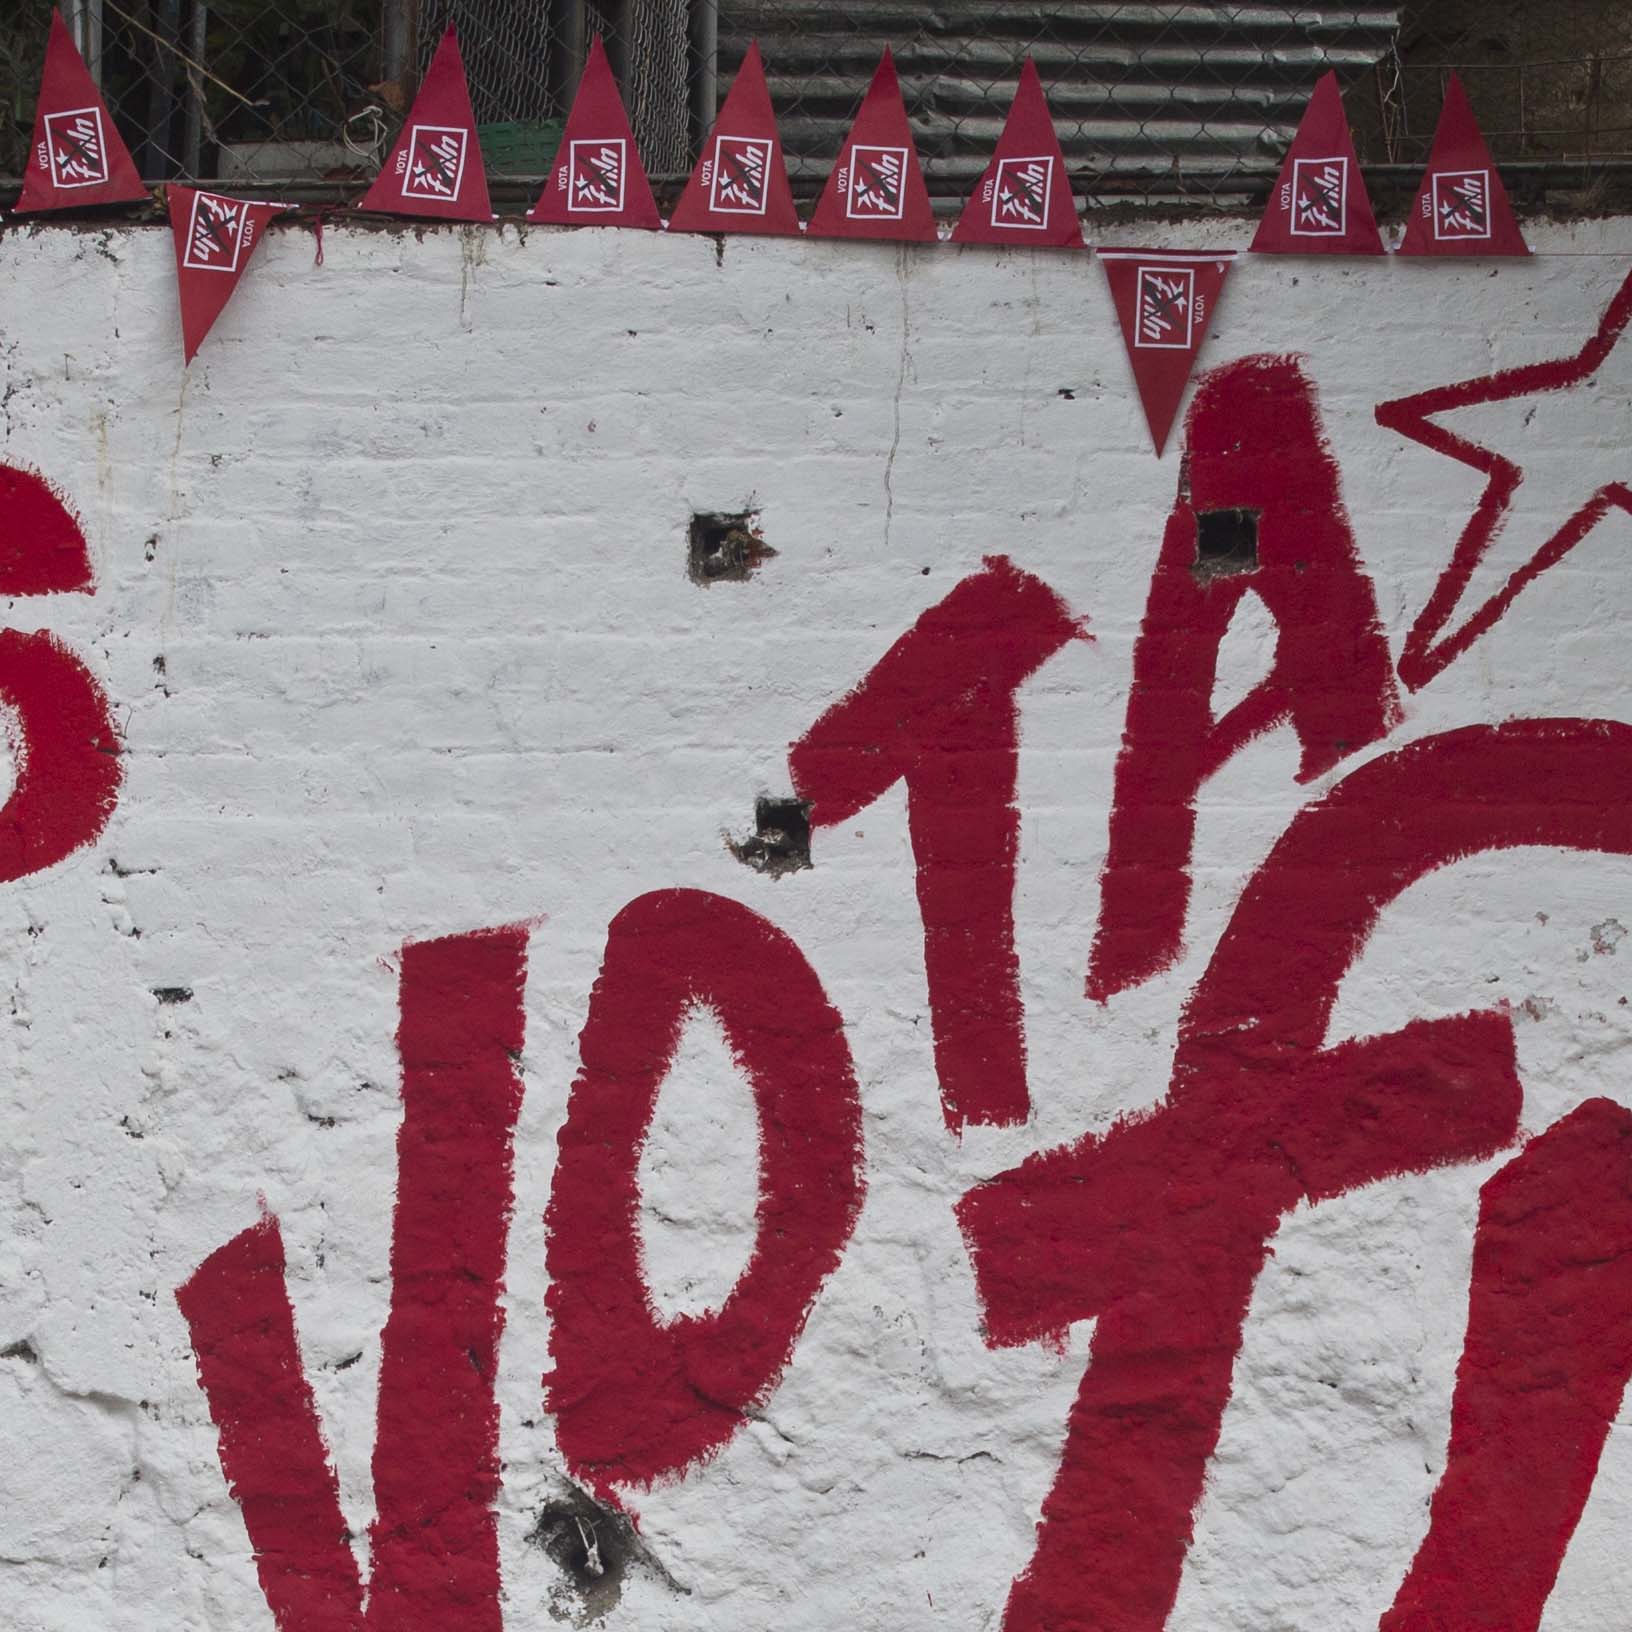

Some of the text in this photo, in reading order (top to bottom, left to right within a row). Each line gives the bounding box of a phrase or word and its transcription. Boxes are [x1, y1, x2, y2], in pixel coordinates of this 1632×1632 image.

[38, 141, 49, 170] VOTA
[394, 149, 409, 176] VOTA
[557, 164, 569, 192] VOTA
[700, 159, 713, 188] VOTA
[837, 166, 849, 194] VOTA
[982, 179, 995, 205] VOTA
[1279, 182, 1292, 211] VOTA
[1421, 192, 1432, 219] VOTA
[241, 219, 255, 248] VOTA
[1194, 294, 1206, 324] VOTA
